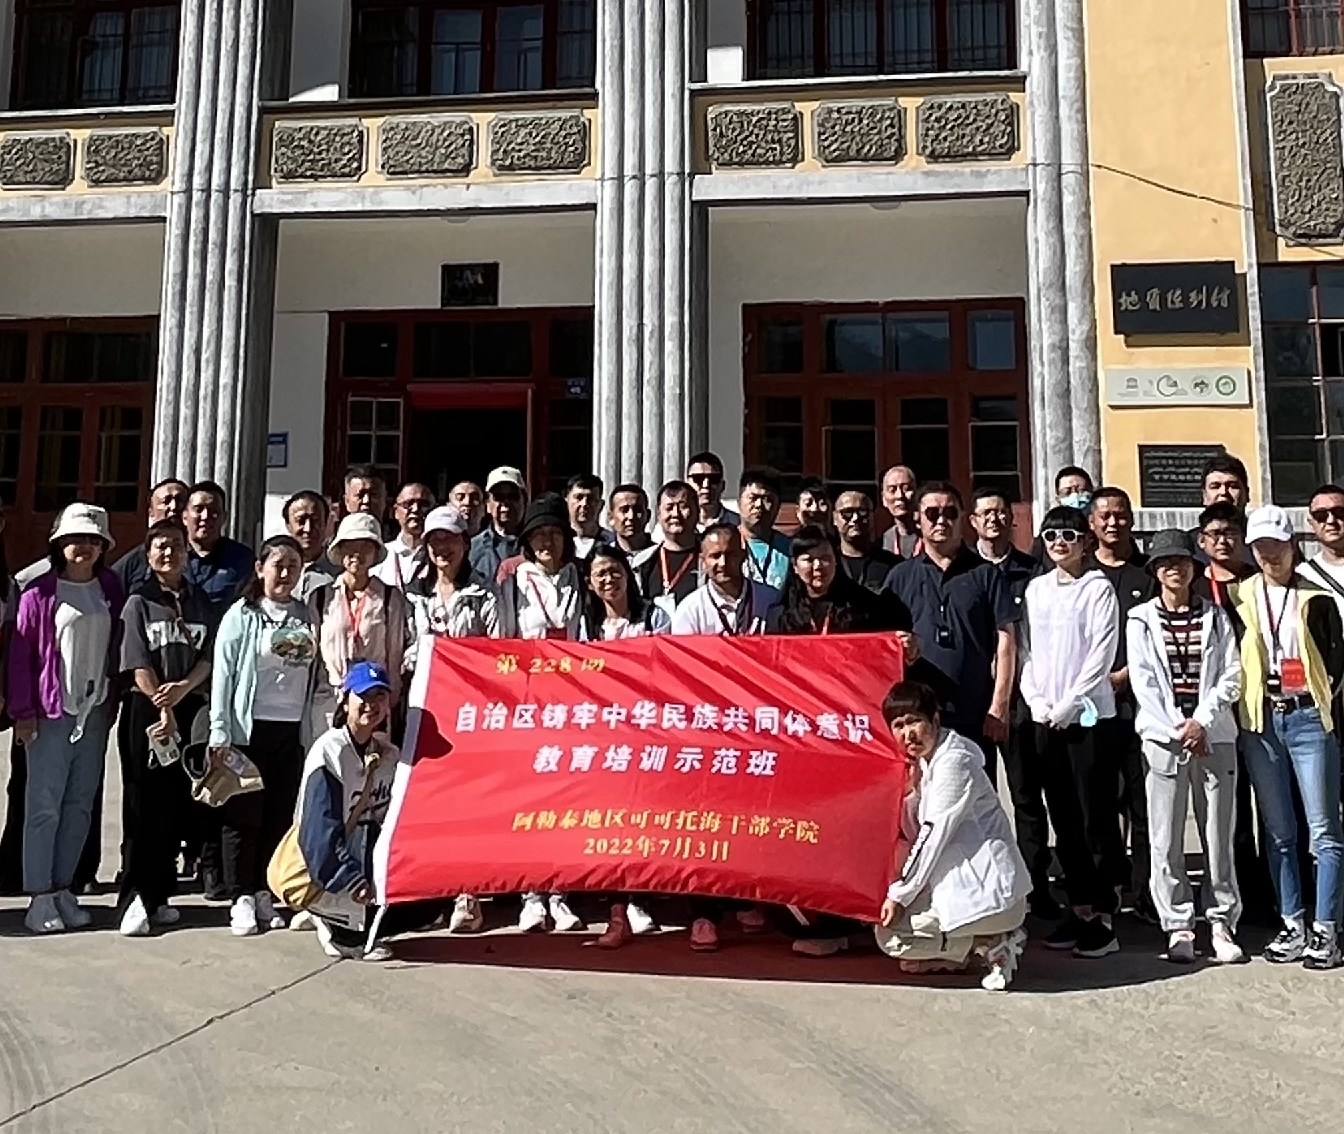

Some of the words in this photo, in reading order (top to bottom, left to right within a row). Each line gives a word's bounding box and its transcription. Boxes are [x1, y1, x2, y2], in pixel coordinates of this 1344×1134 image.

[528, 655, 573, 674] 228
[454, 700, 874, 745] 自治区铸牢中华民族共同体意识
[532, 743, 779, 777] 教育培训示范班
[511, 808, 821, 845] 阿勒泰地区可可托海干部学院
[582, 835, 731, 862] 2022年7月3日
